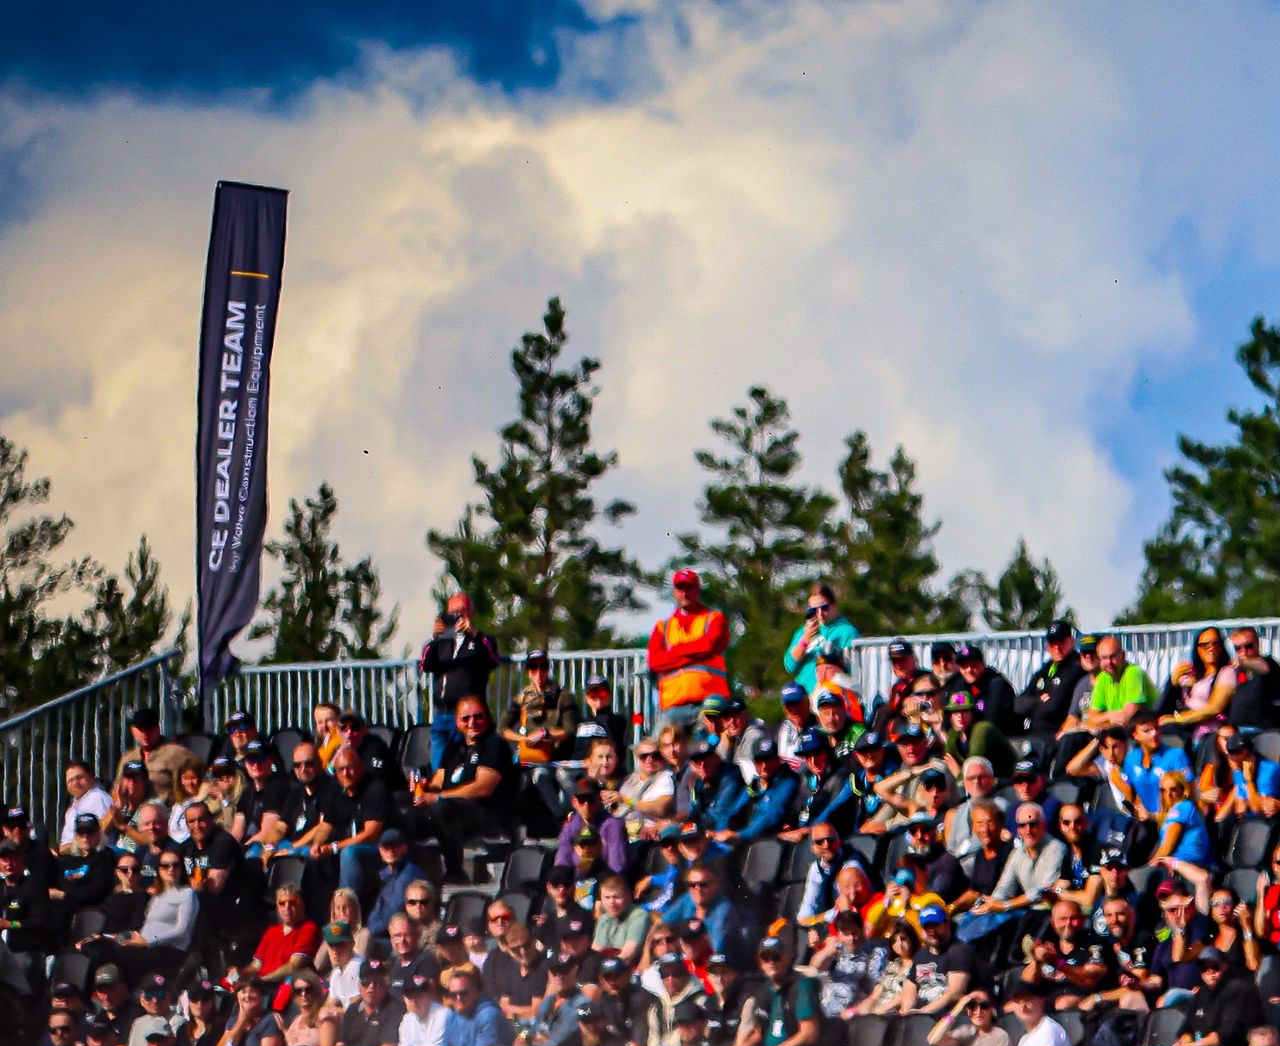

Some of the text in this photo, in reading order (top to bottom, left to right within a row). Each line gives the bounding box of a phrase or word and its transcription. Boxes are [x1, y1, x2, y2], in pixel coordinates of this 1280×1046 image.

[247, 304, 267, 393] Equipment
[209, 301, 247, 573] CE DEALER TEAM
[239, 398, 259, 501] Construction
[232, 506, 246, 549] Volvo
